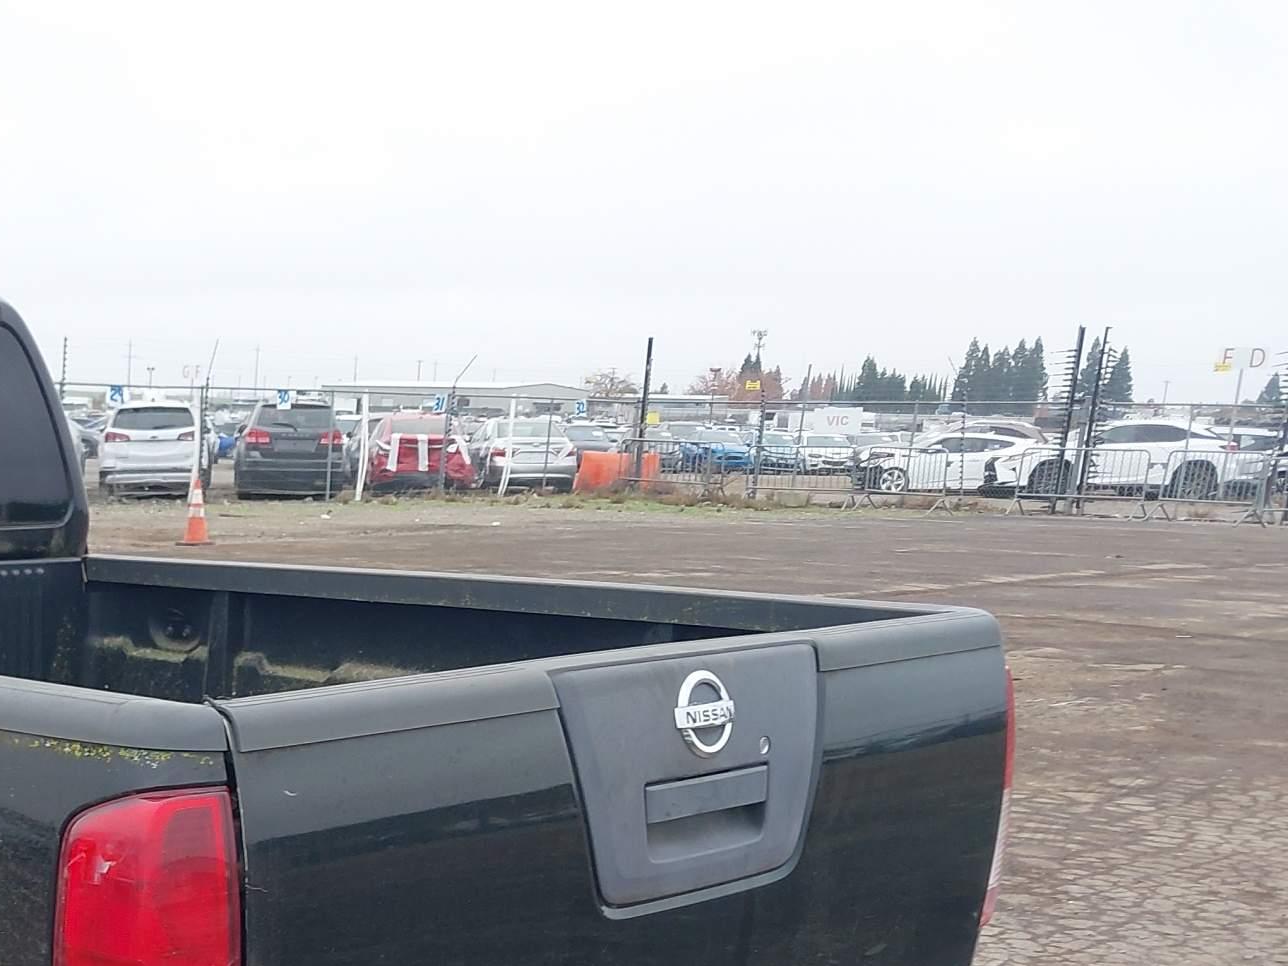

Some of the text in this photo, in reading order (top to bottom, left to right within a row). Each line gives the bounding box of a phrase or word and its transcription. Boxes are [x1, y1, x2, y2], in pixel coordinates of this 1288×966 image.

[1249, 347, 1266, 368] D
[277, 390, 290, 405] 30
[434, 396, 446, 411] 31
[826, 415, 849, 426] VIC
[685, 706, 732, 724] NISSAN
